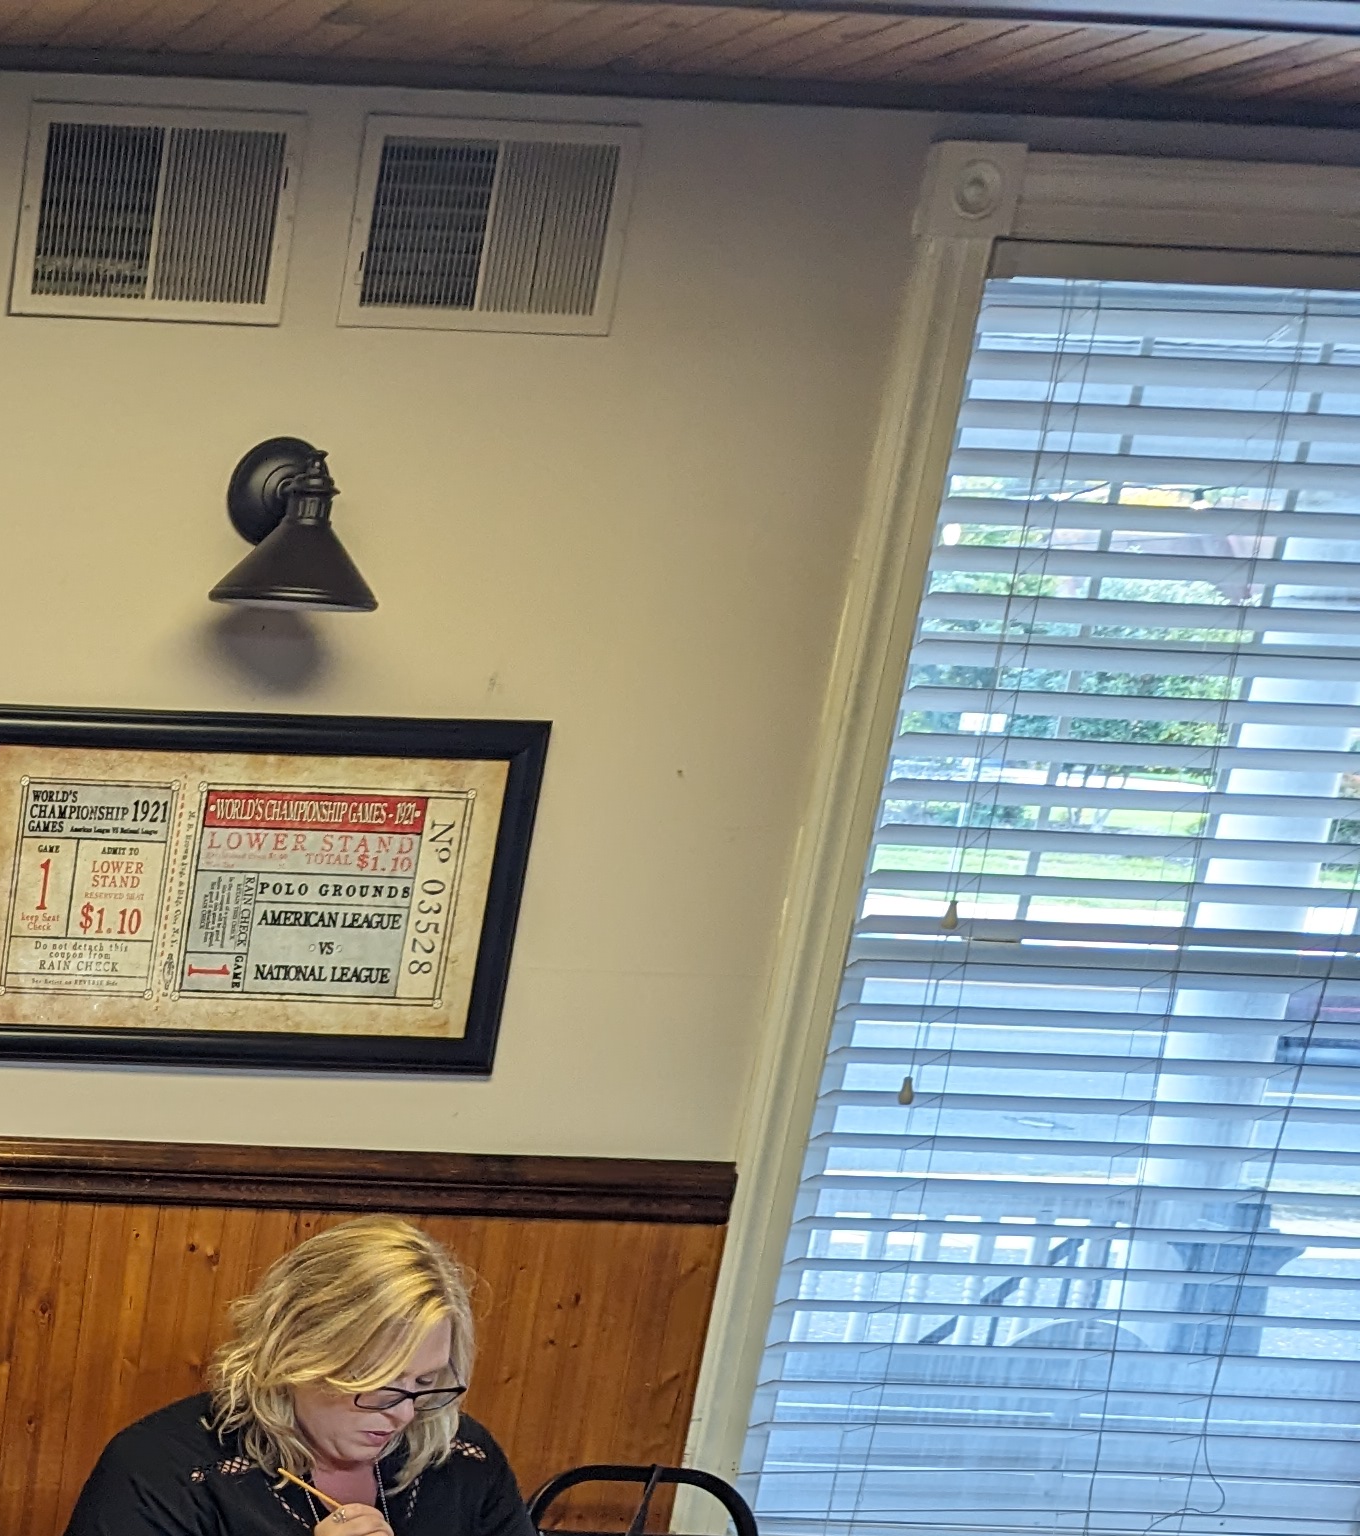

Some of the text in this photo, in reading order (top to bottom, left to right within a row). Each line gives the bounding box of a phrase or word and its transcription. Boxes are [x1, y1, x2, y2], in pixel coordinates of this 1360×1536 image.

[32, 790, 79, 804] WORLD'S
[29, 799, 169, 824] CHAMPIONSHIP 1921
[216, 798, 263, 821] WORLD'S
[264, 799, 348, 823] CHAMPIONSHIP
[348, 802, 388, 824] GAMES
[394, 802, 416, 825] 1921
[28, 820, 64, 833] GAMES
[37, 844, 60, 854] GAME
[207, 831, 414, 854] LOWER STAND
[101, 847, 140, 856] ADMIT TO
[91, 860, 144, 875] LOWER
[305, 853, 353, 866] TOTAL
[356, 853, 412, 873] $1.10
[35, 858, 51, 910] 1
[91, 874, 140, 889] STAND
[258, 882, 411, 898] POLO GROUNDS
[80, 901, 142, 935] $1.10
[236, 876, 256, 947] RAIN CHECK
[258, 909, 402, 930] AMERICAN LEAGUE
[27, 921, 52, 931] Check
[407, 879, 447, 976] 03528
[34, 940, 129, 953] Do not detach this
[318, 942, 334, 955] VS
[49, 950, 111, 962] coupon from
[38, 959, 119, 972] RAIN CHECK
[231, 955, 244, 988] GAME
[253, 964, 391, 984] NATIONAL LEAGUE
